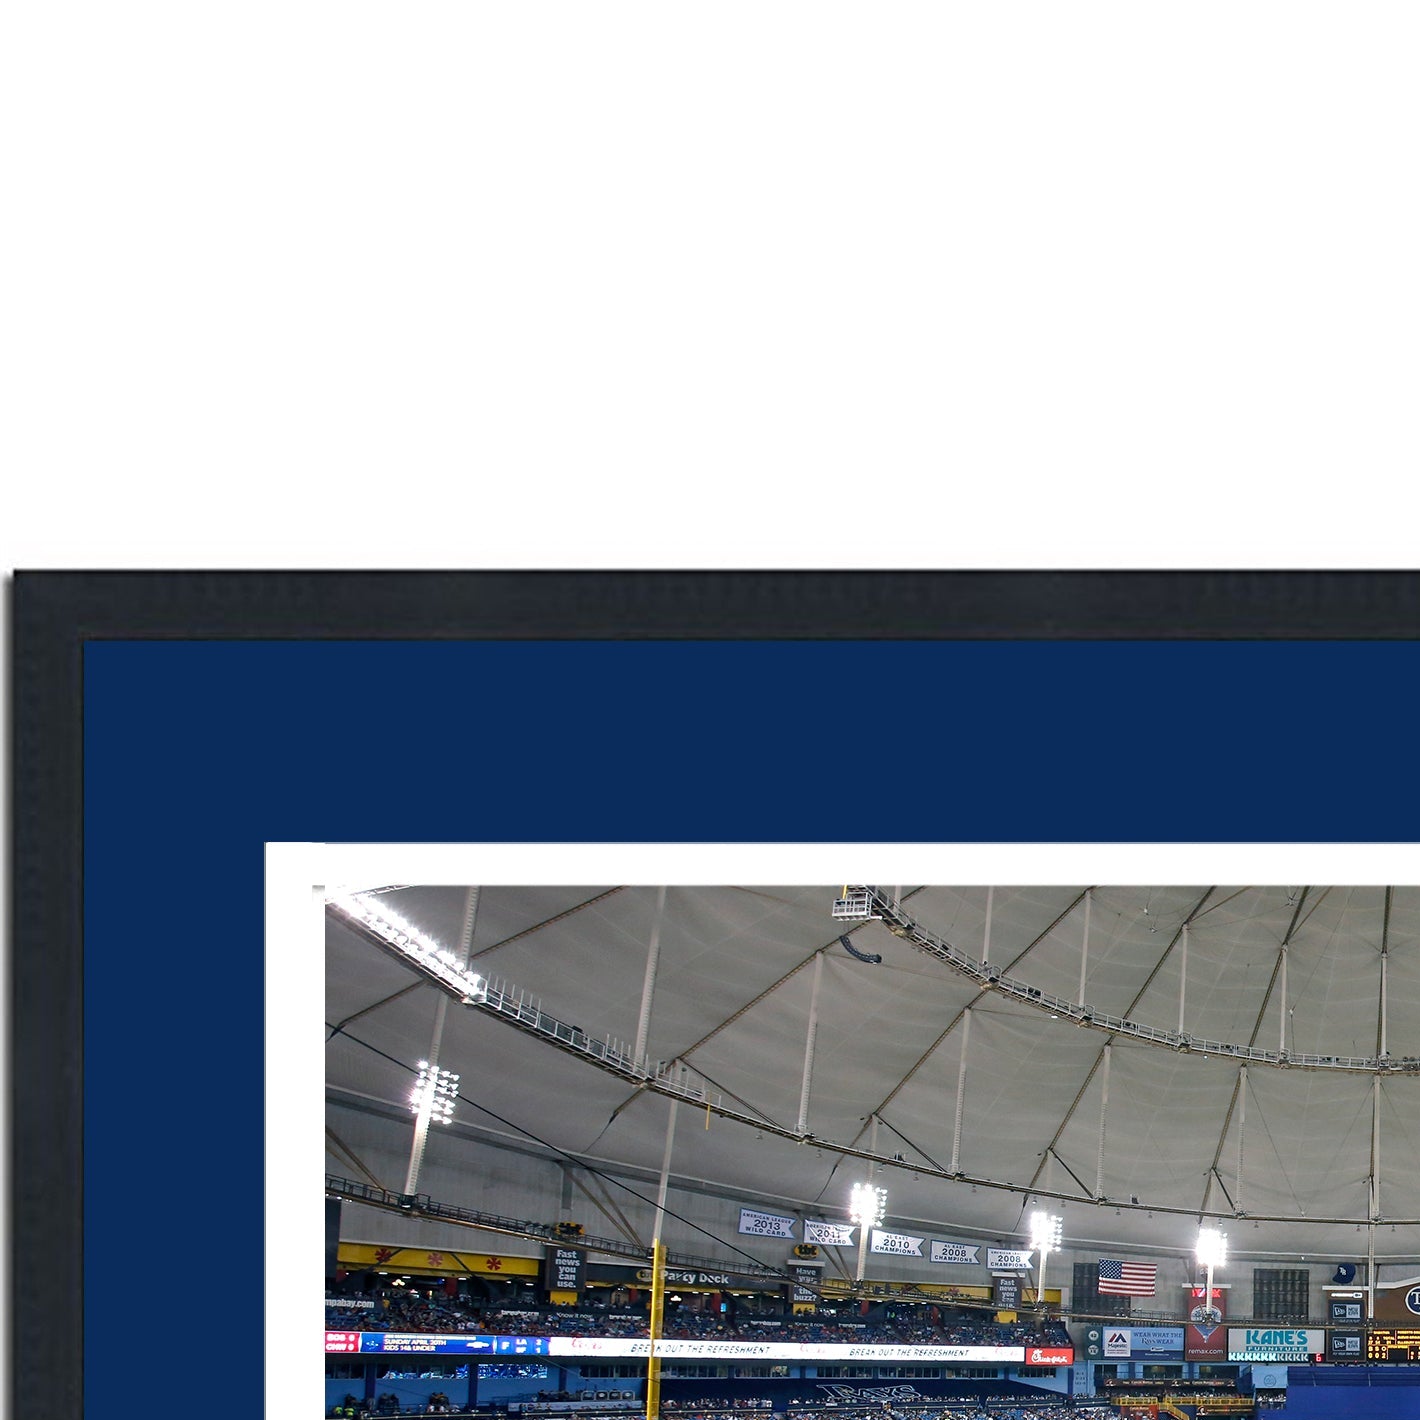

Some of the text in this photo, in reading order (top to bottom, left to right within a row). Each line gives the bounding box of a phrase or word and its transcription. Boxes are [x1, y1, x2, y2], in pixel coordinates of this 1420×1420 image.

[754, 1219, 780, 1231] 2013
[745, 1226, 786, 1237] WILD CARD
[883, 1238, 910, 1249] 2010
[557, 1250, 577, 1259] Fast
[875, 1245, 916, 1255] CHAMPIONS
[942, 1248, 967, 1258] 2008
[555, 1259, 580, 1267] news
[934, 1255, 972, 1263] CHAMPIONS
[997, 1255, 1021, 1263] 2008
[559, 1267, 576, 1275] you
[796, 1267, 817, 1276] Have
[559, 1273, 576, 1281] can
[1000, 1278, 1016, 1286] Fast
[1246, 1330, 1308, 1345] KANE'S
